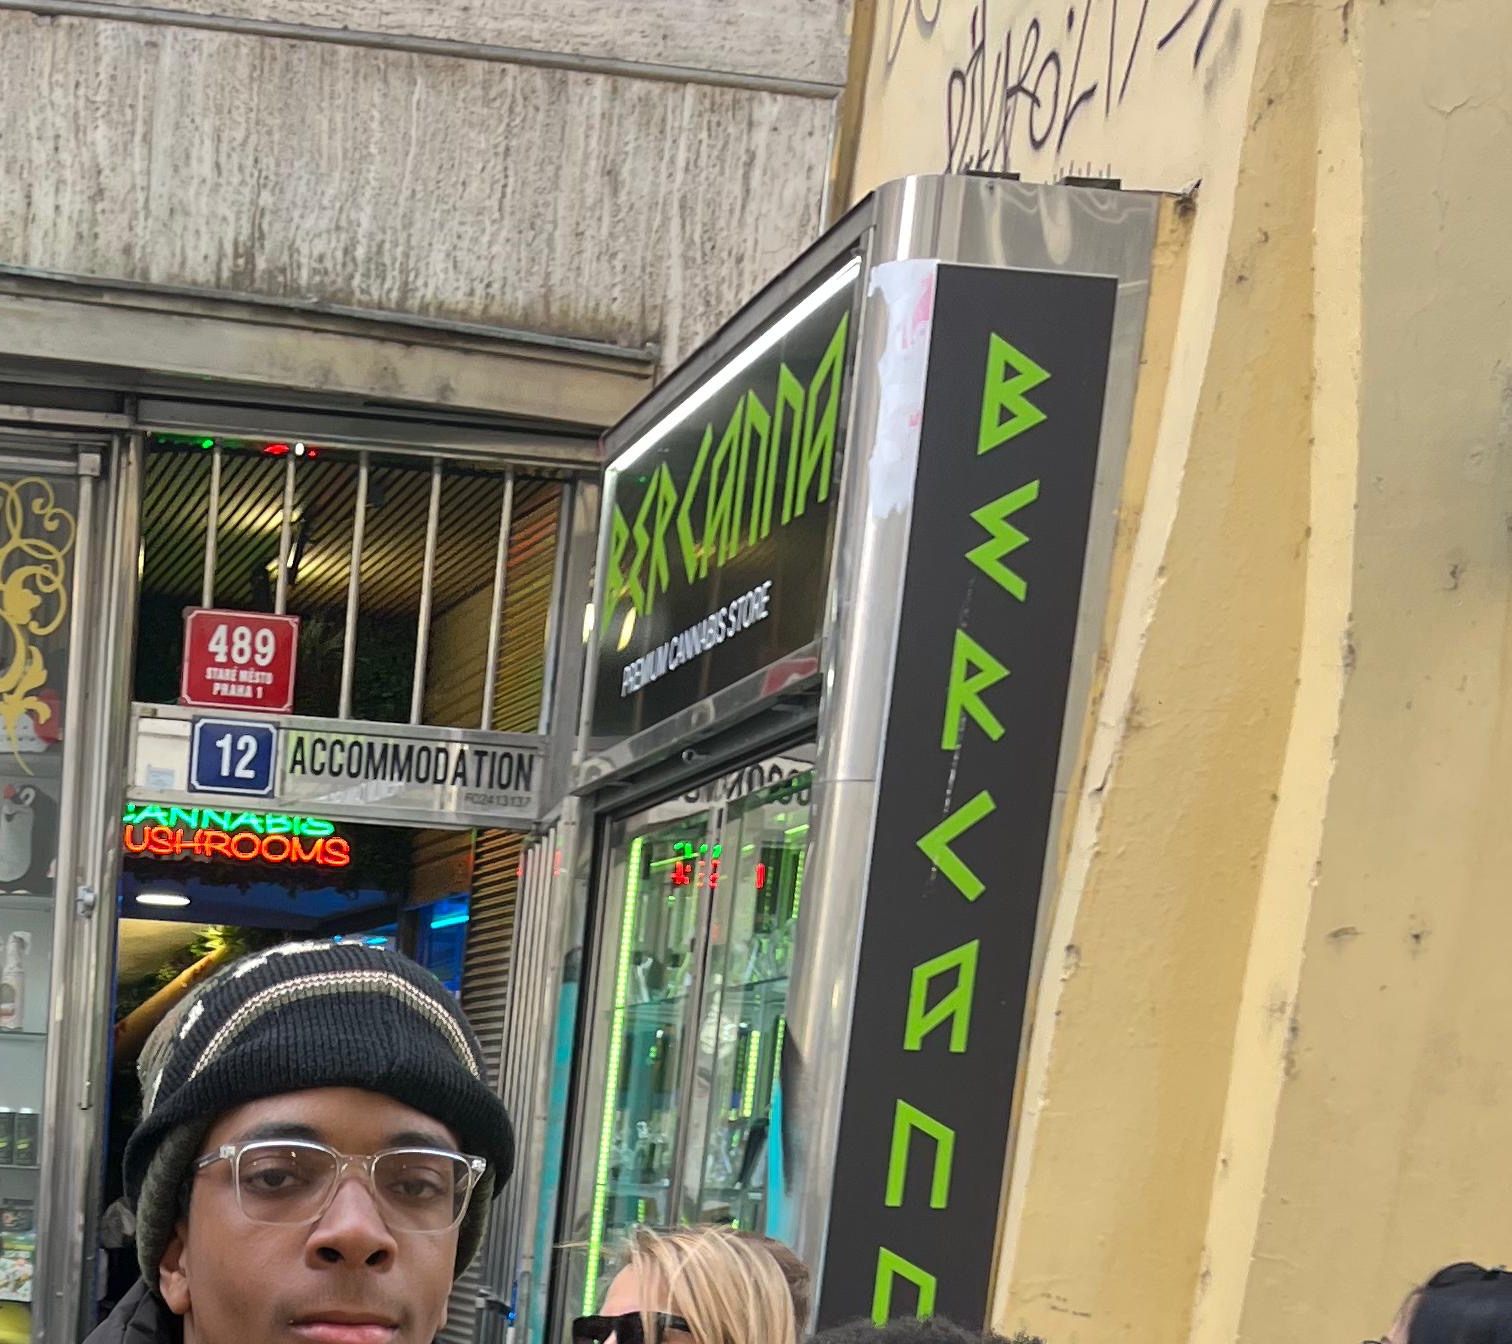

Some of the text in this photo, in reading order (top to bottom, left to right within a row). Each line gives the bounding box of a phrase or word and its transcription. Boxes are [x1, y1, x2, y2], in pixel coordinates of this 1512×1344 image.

[726, 580, 773, 638] STORE
[207, 624, 276, 667] 489
[205, 666, 274, 685] STARÉ MĚSTO
[212, 682, 264, 699] PRAHA 1
[215, 733, 259, 779] 12
[289, 736, 535, 791] ACCOMMODATION
